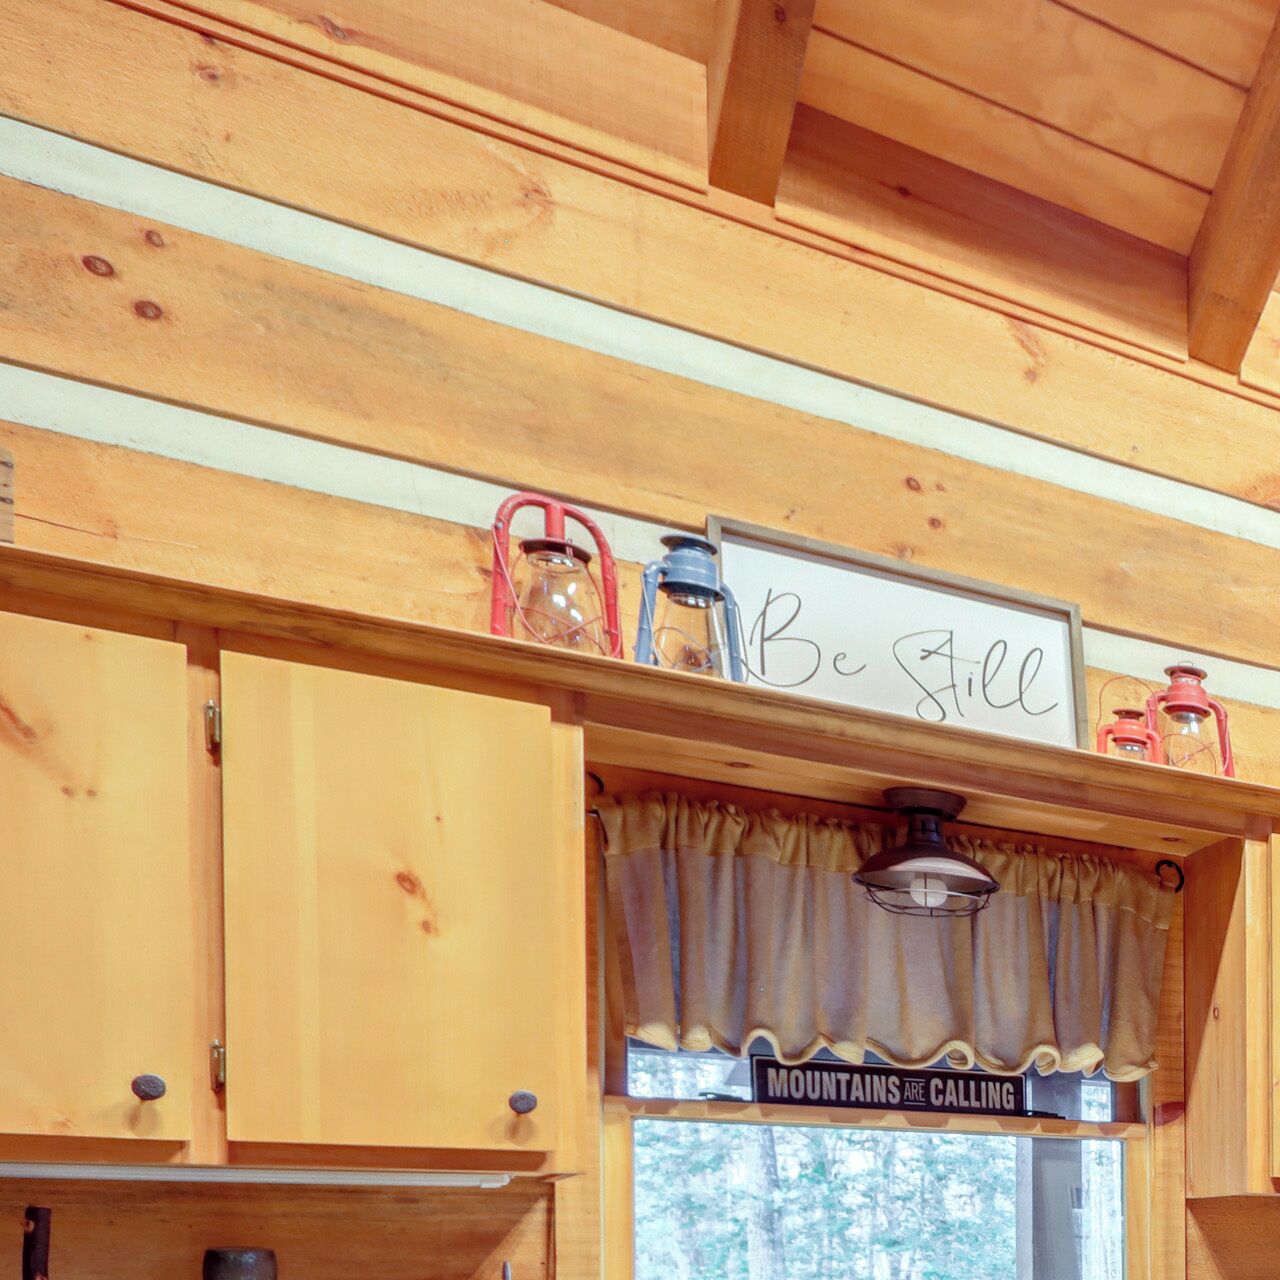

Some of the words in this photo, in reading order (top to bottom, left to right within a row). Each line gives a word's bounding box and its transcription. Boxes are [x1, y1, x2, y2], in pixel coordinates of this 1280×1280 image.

[741, 587, 867, 689] Be
[892, 629, 1059, 723] Still
[766, 1067, 901, 1105] MOUNTAINS
[903, 1080, 927, 1102] ARE
[929, 1077, 1015, 1111] CALLING
